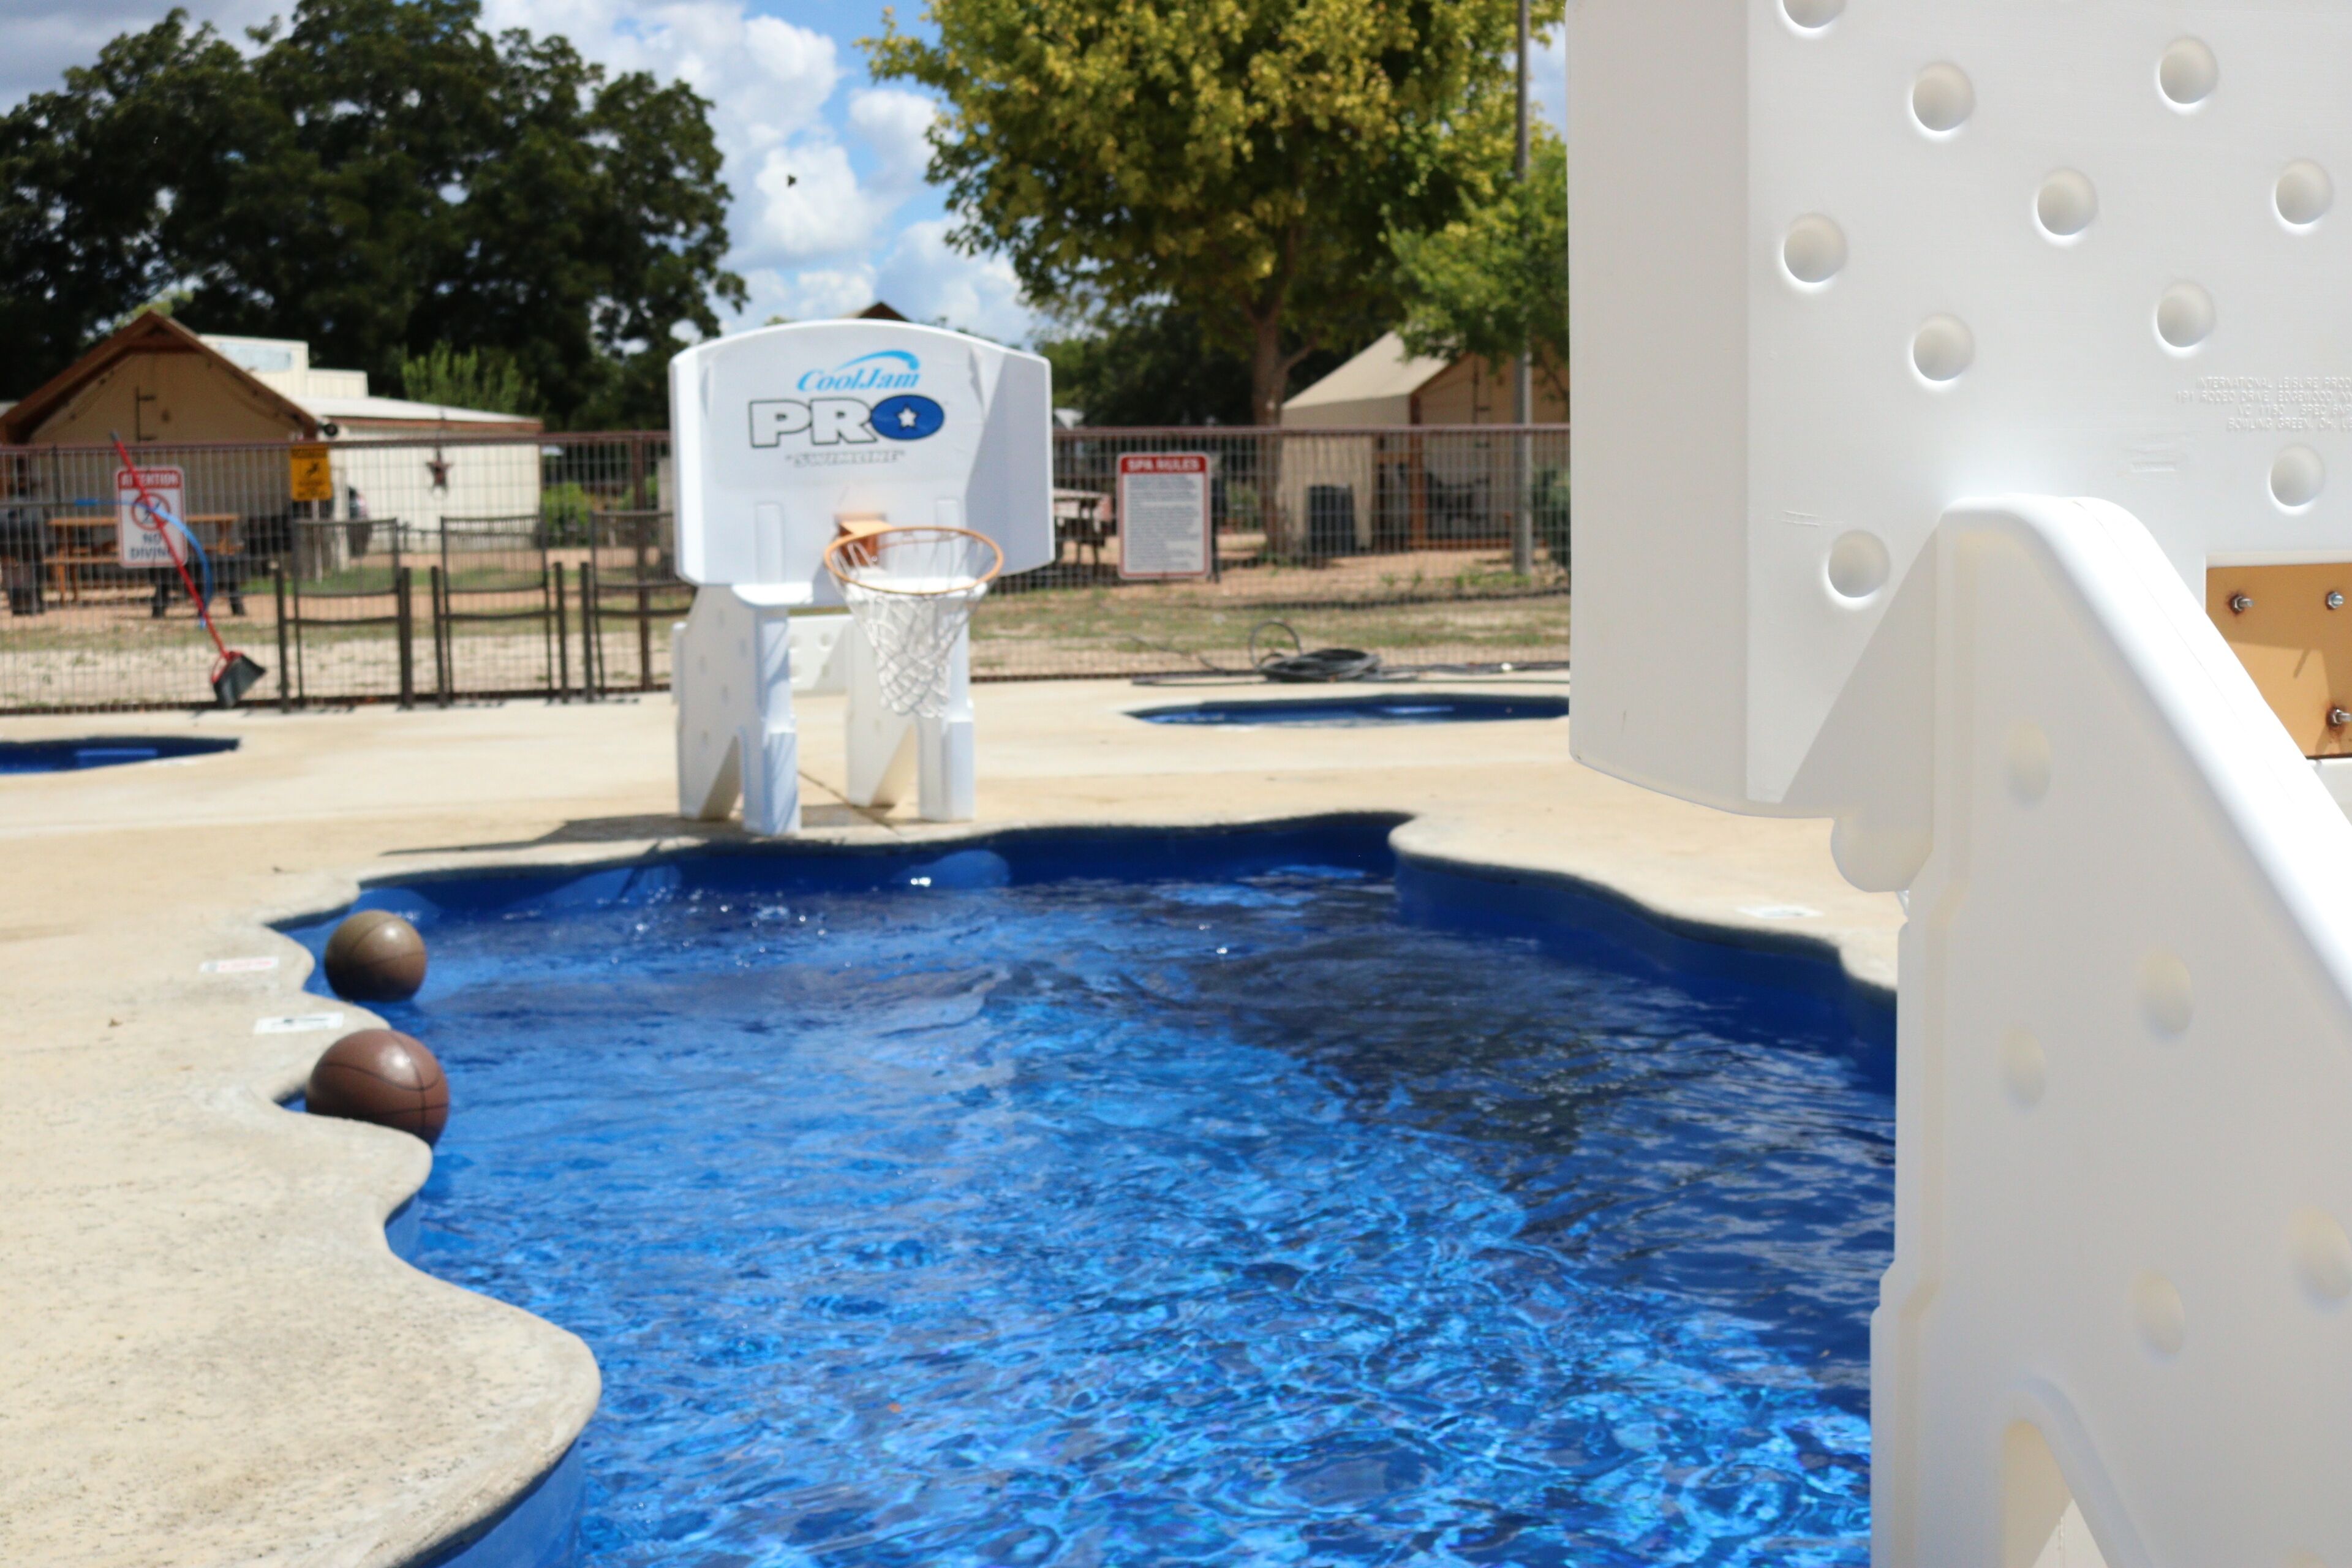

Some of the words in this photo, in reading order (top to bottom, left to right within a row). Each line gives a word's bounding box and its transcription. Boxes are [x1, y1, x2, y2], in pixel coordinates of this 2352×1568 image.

[2196, 376, 2273, 388] INTERNATIONAL
[2277, 376, 2318, 388] LEISURE
[2200, 390, 2235, 402] RODEO
[2228, 418, 2272, 430] BOWLING
